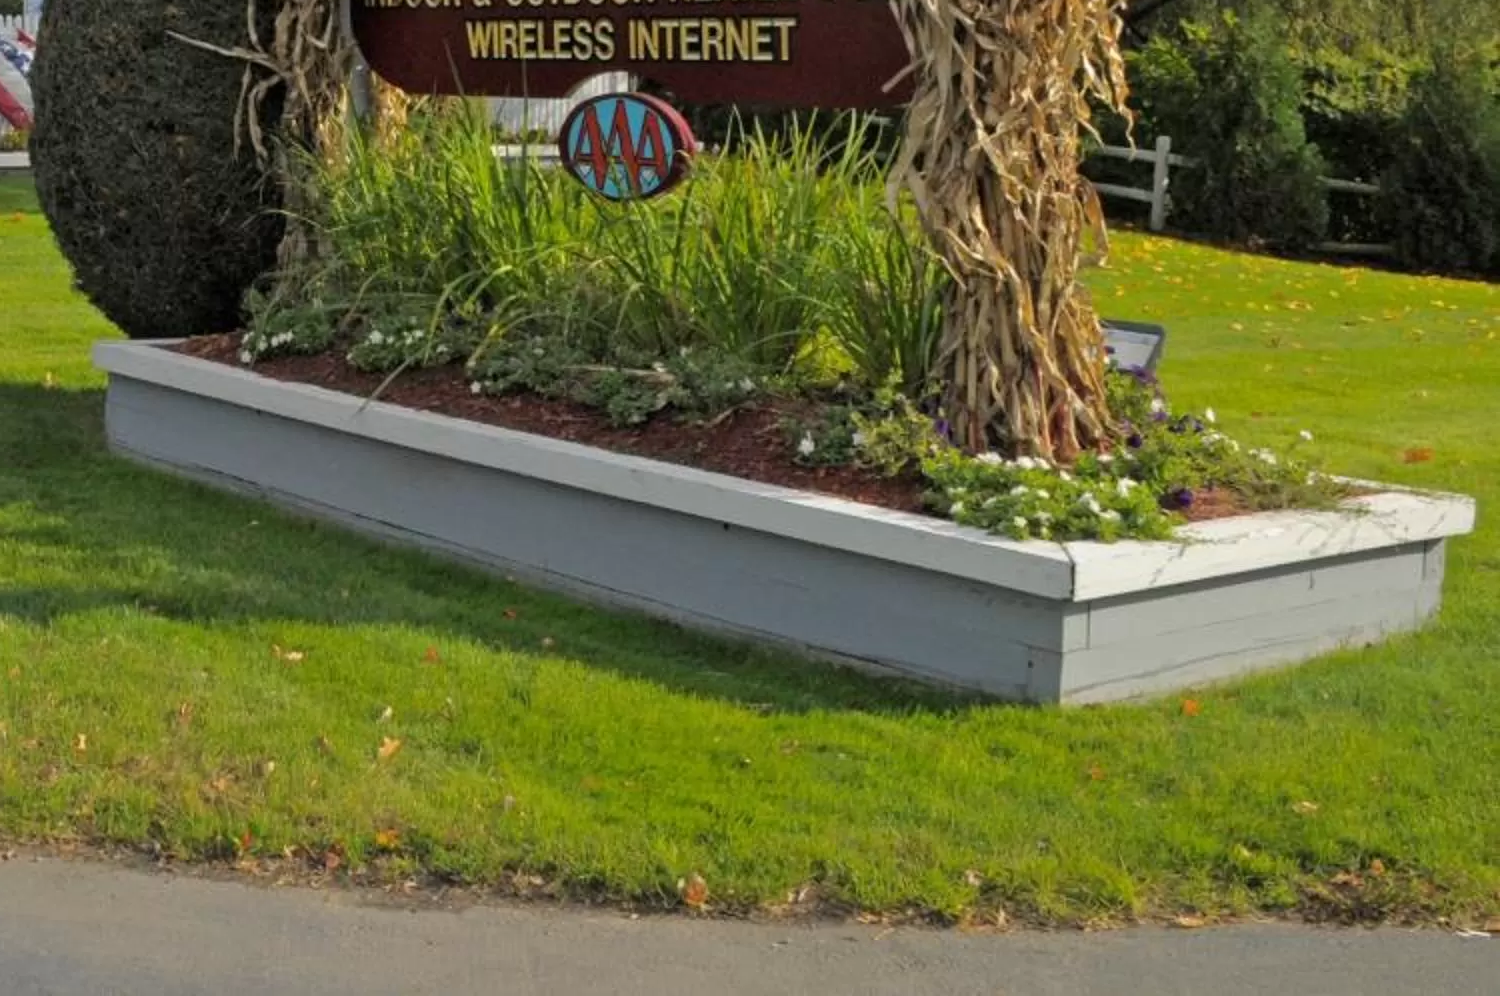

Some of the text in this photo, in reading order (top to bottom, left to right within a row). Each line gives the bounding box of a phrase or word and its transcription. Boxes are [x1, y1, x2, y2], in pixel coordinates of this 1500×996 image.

[465, 18, 797, 61] WIRELESS INTERNET
[572, 99, 668, 198] AAA
